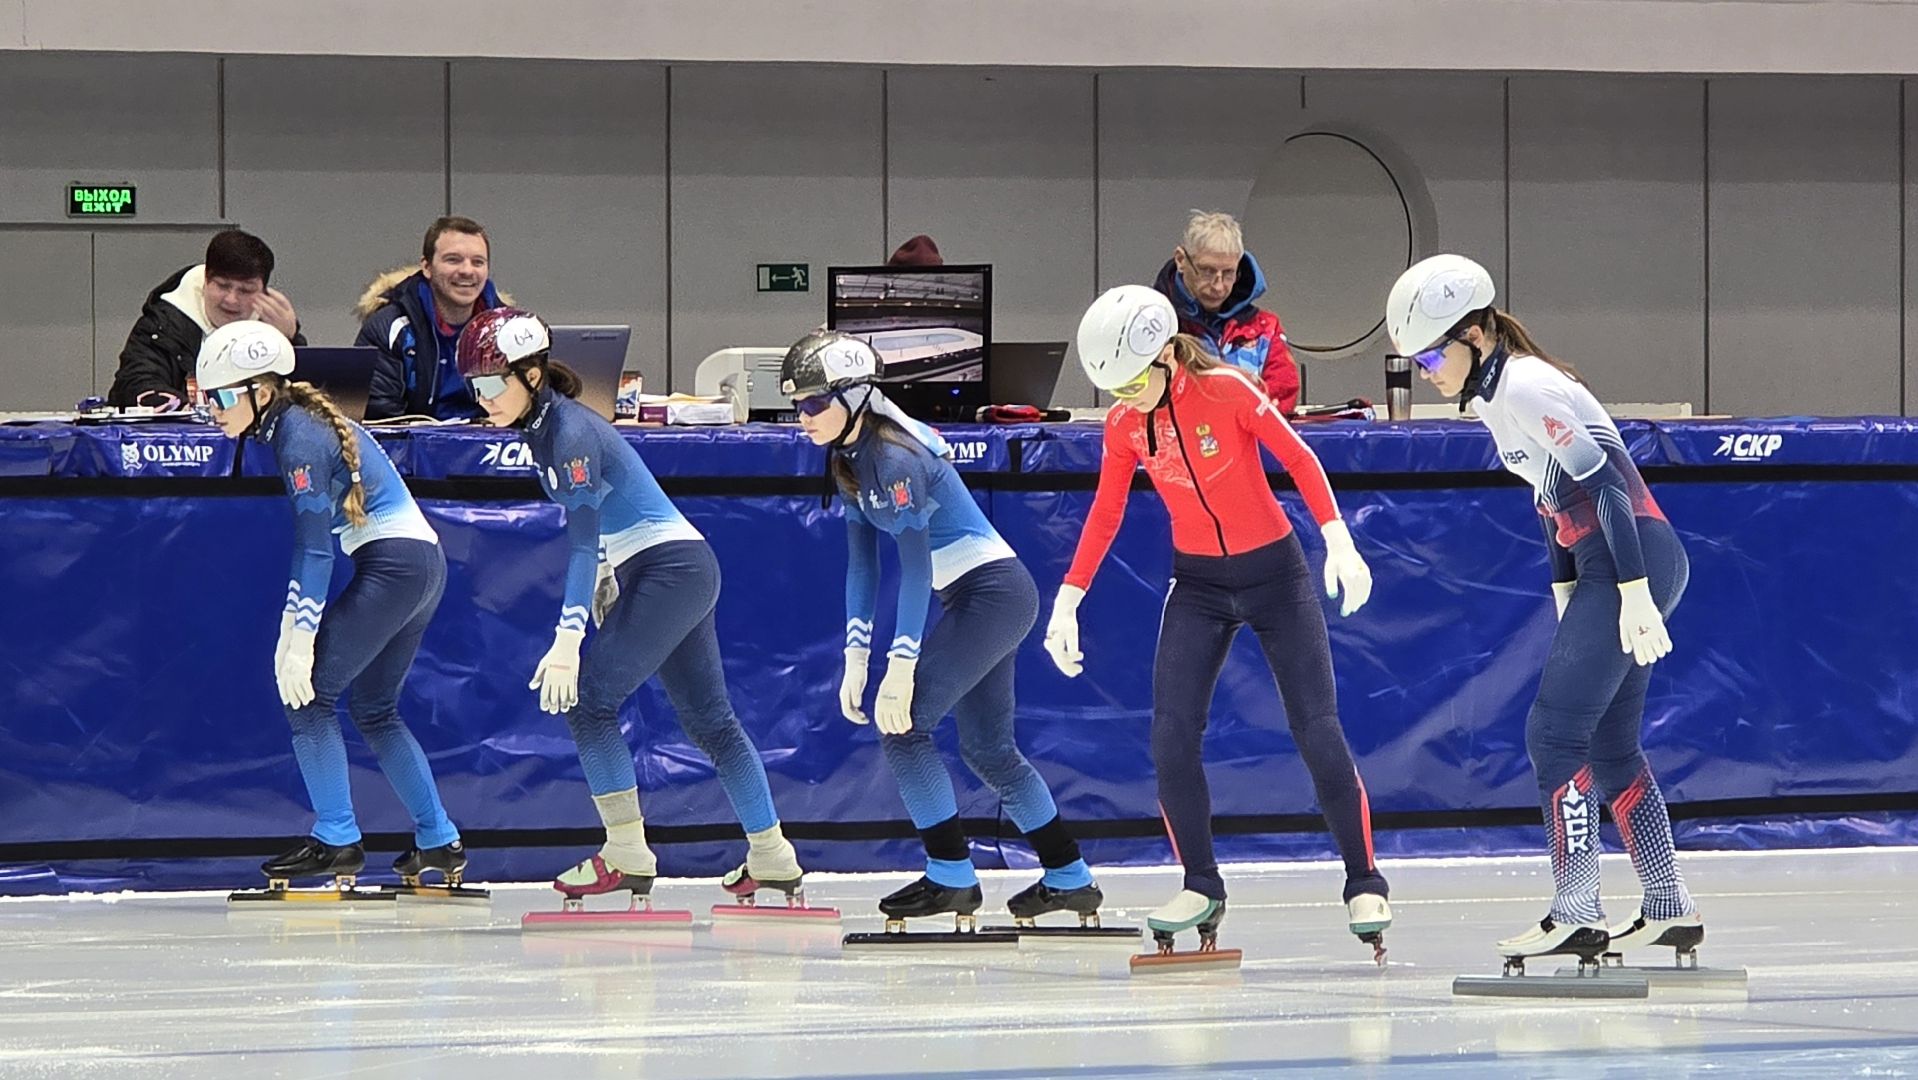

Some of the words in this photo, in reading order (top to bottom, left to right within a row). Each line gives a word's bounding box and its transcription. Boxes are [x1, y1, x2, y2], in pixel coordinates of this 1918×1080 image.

[75, 189, 131, 204] ВЫХОД
[82, 202, 122, 212] EXIT
[1443, 284, 1455, 299] 4
[514, 328, 534, 346] 64
[1142, 318, 1163, 342] 30
[247, 340, 268, 360] 63
[844, 350, 864, 368] 56
[143, 444, 213, 462] OLYMP
[501, 441, 534, 466] СК
[945, 442, 988, 459] YMP
